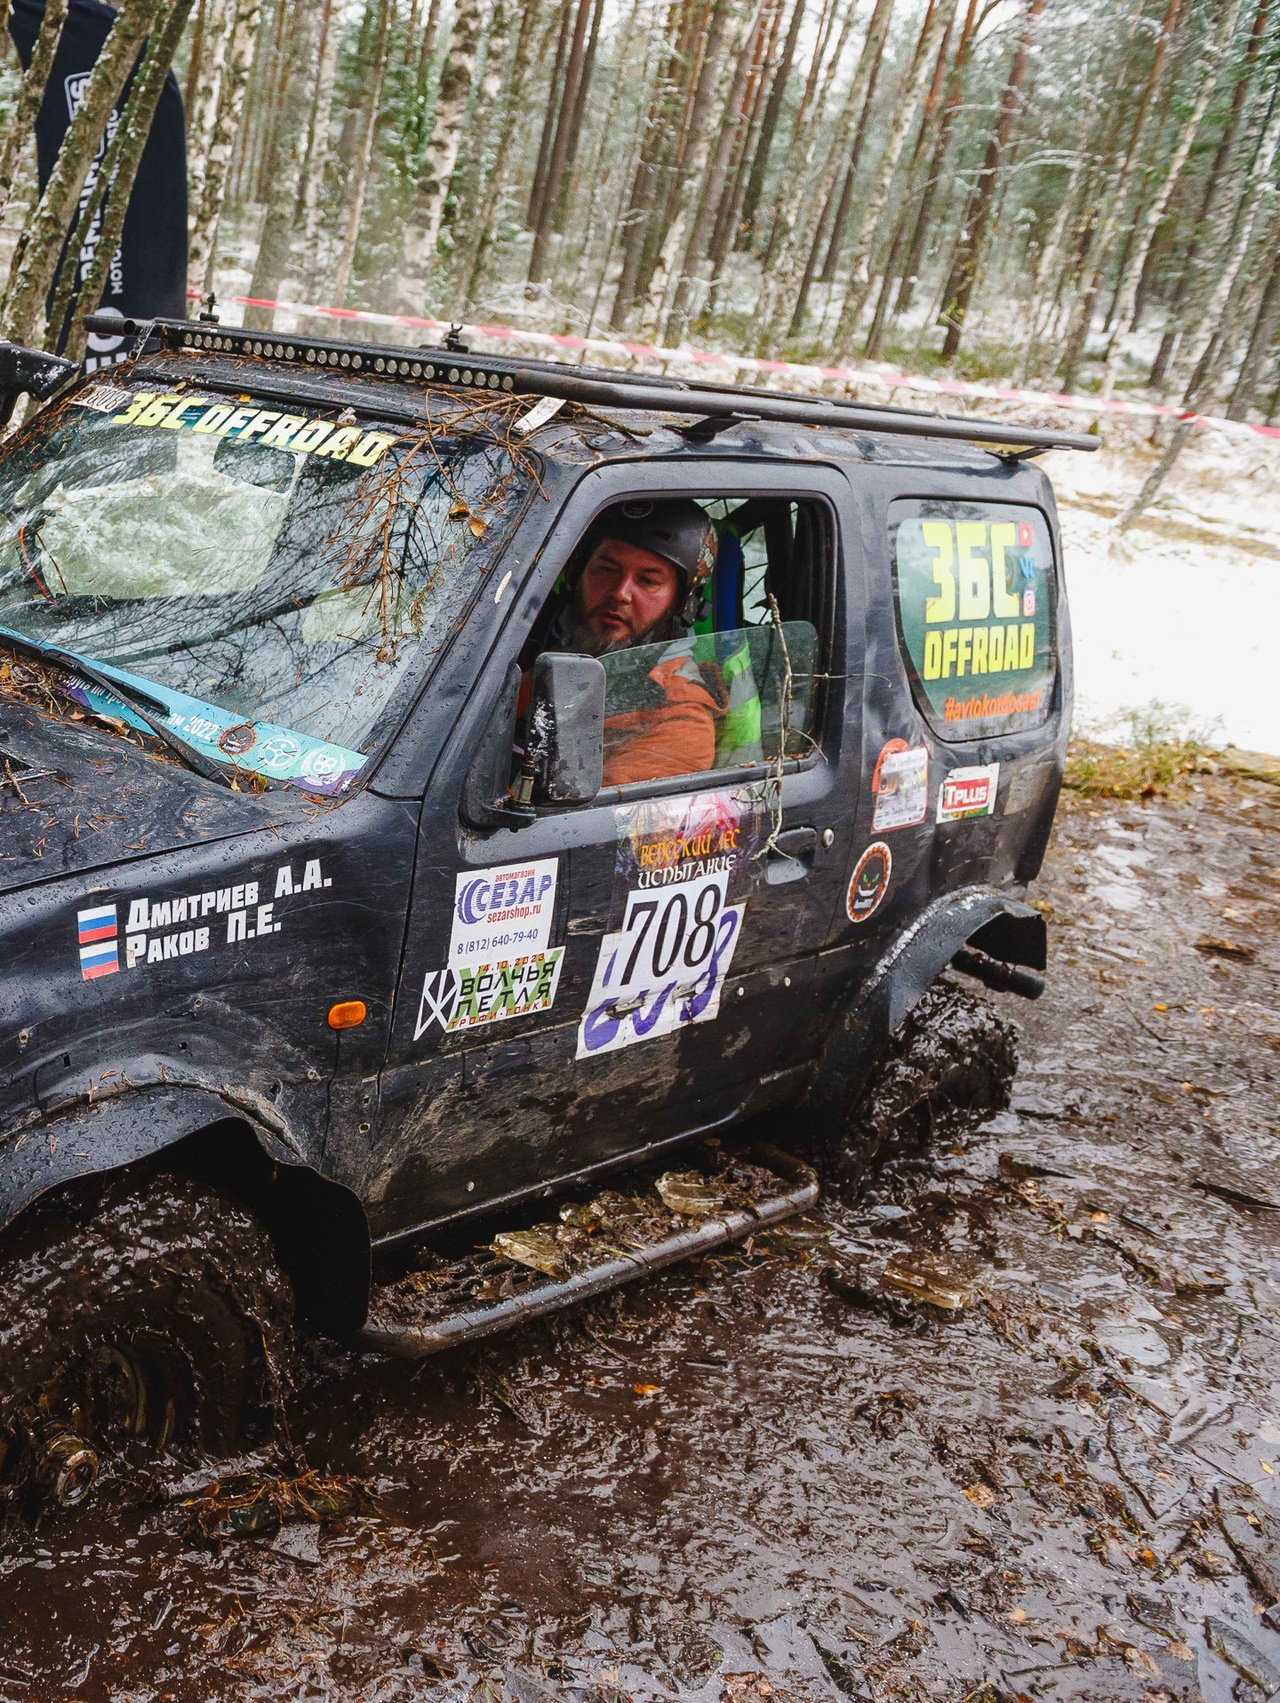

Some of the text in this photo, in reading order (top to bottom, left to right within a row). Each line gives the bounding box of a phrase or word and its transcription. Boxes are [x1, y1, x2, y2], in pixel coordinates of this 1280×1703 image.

[191, 406, 396, 468] OFFROAD
[923, 623, 1036, 681] OFFROAD
[183, 715, 219, 740] 2022
[274, 858, 333, 898] А.А.
[475, 875, 552, 912] СЕЗАР
[495, 868, 535, 883] автомагазин
[226, 903, 282, 943] П.Е.
[487, 904, 542, 924] sezarshop.ru
[457, 928, 539, 955] 8 (812) 640-79-40
[620, 883, 722, 986] 708
[460, 960, 557, 997] ВОЛЧЬЯ
[477, 952, 545, 975] 14.10.2023
[455, 981, 551, 1019] ПЕТЛЯ
